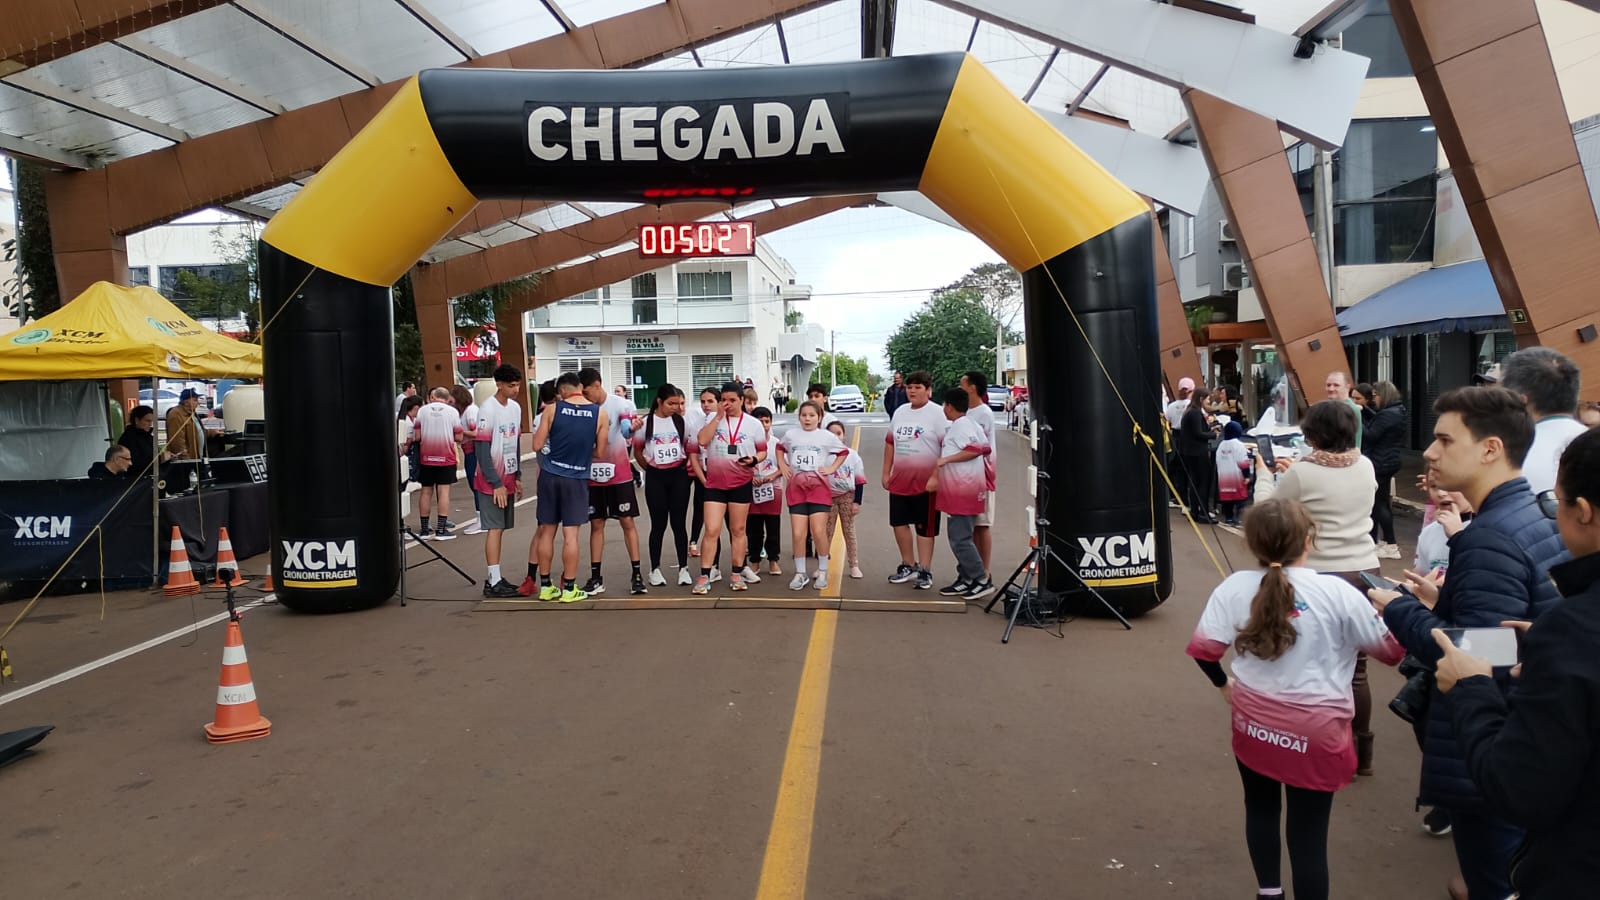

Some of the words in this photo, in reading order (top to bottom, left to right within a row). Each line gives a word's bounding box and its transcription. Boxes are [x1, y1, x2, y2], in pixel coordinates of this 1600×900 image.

[528, 98, 846, 162] CHEGADA
[54, 328, 105, 339] XCM
[561, 407, 593, 418] ATLETA
[896, 426, 914, 436] 439
[657, 447, 678, 459] 549
[507, 457, 517, 469] 52
[796, 454, 814, 466] 541
[592, 466, 611, 478] 556
[754, 486, 773, 499] 555
[14, 515, 72, 539] XCM
[281, 539, 356, 570] XCM
[1077, 531, 1156, 568] XCM
[283, 569, 357, 580] CRONOMETRAGEM
[1079, 563, 1157, 578] CRONOMETRAGEM
[224, 692, 247, 702] XCM
